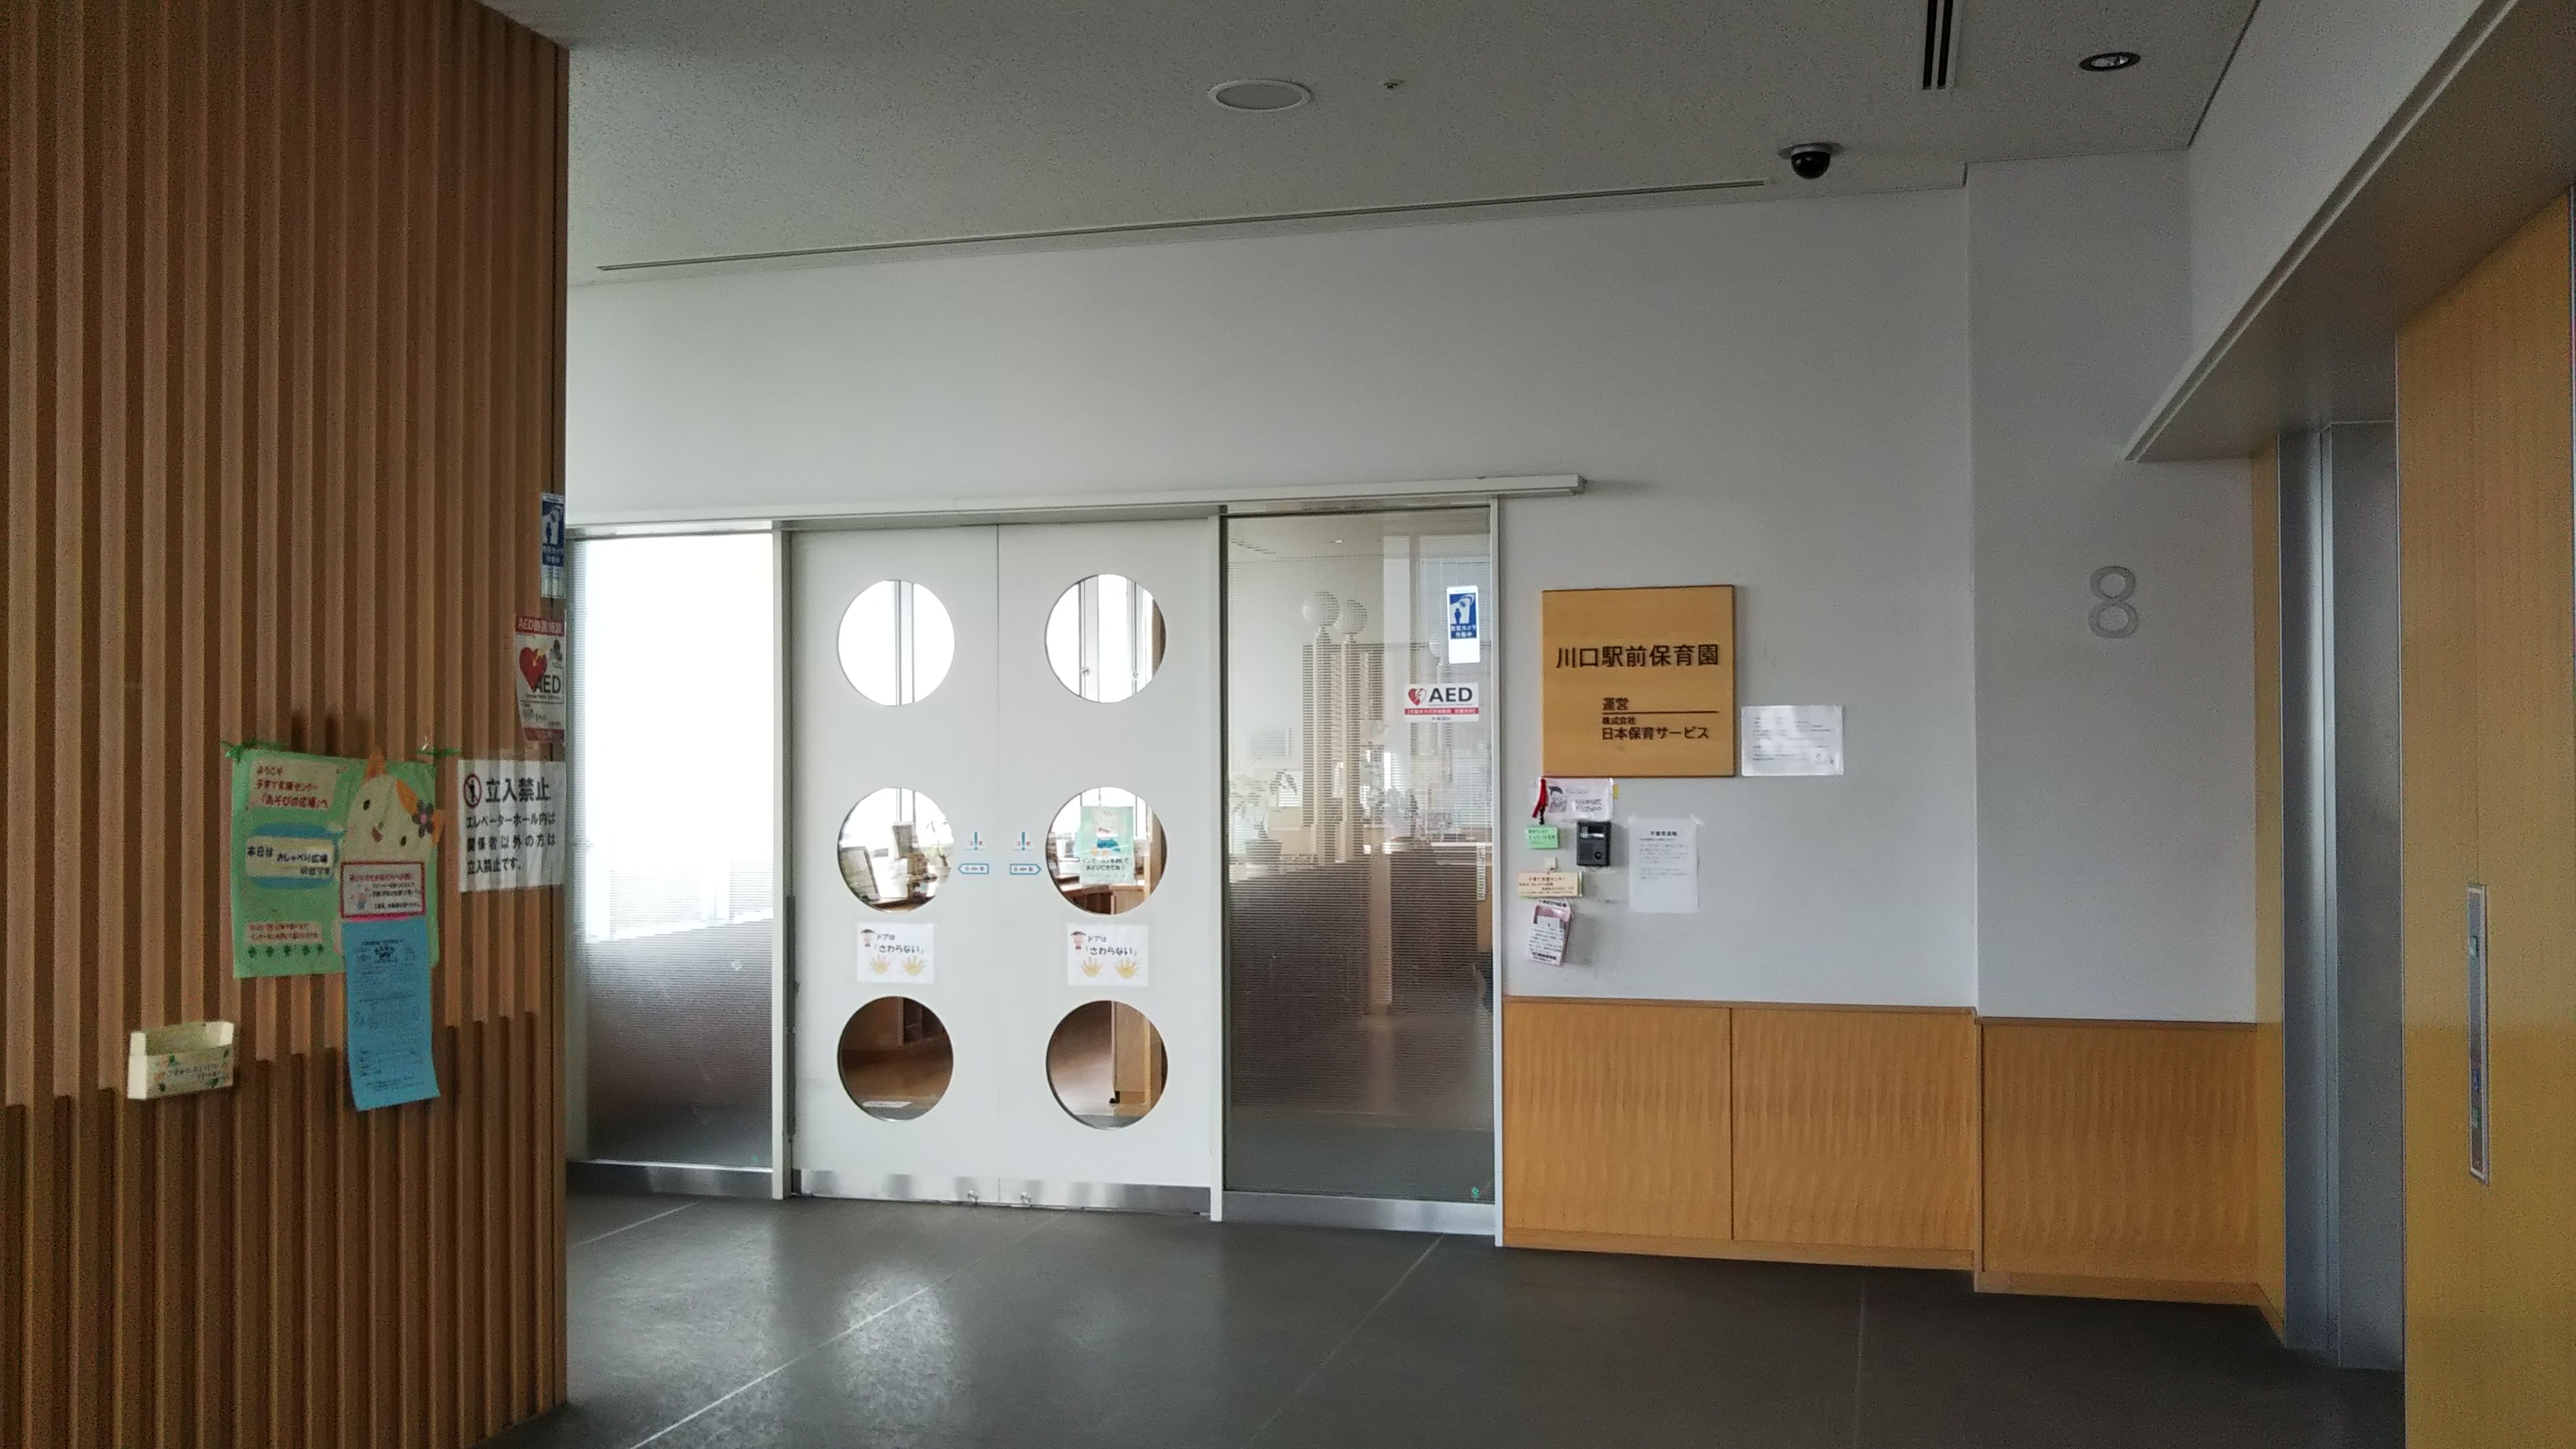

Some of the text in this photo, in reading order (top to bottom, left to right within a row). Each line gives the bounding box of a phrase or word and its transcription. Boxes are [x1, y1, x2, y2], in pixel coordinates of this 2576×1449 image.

[2088, 566, 2138, 639] 8
[1556, 643, 1720, 669] 川口駅前保育園
[534, 674, 561, 694] AED
[1428, 686, 1473, 703] AED
[1601, 697, 1629, 711] 運営
[1601, 716, 1636, 725] 株式会社
[1601, 727, 1710, 741] 日本保育サービス
[486, 776, 551, 803] 立入禁止
[466, 812, 556, 828] エレベーターホール内は
[466, 833, 556, 852] 関係者以外の方は
[247, 845, 274, 858] 本日は
[467, 857, 522, 875] 立入禁止です。
[875, 944, 924, 955] 「さわらない」
[1086, 946, 1137, 957] 「さわらない」
